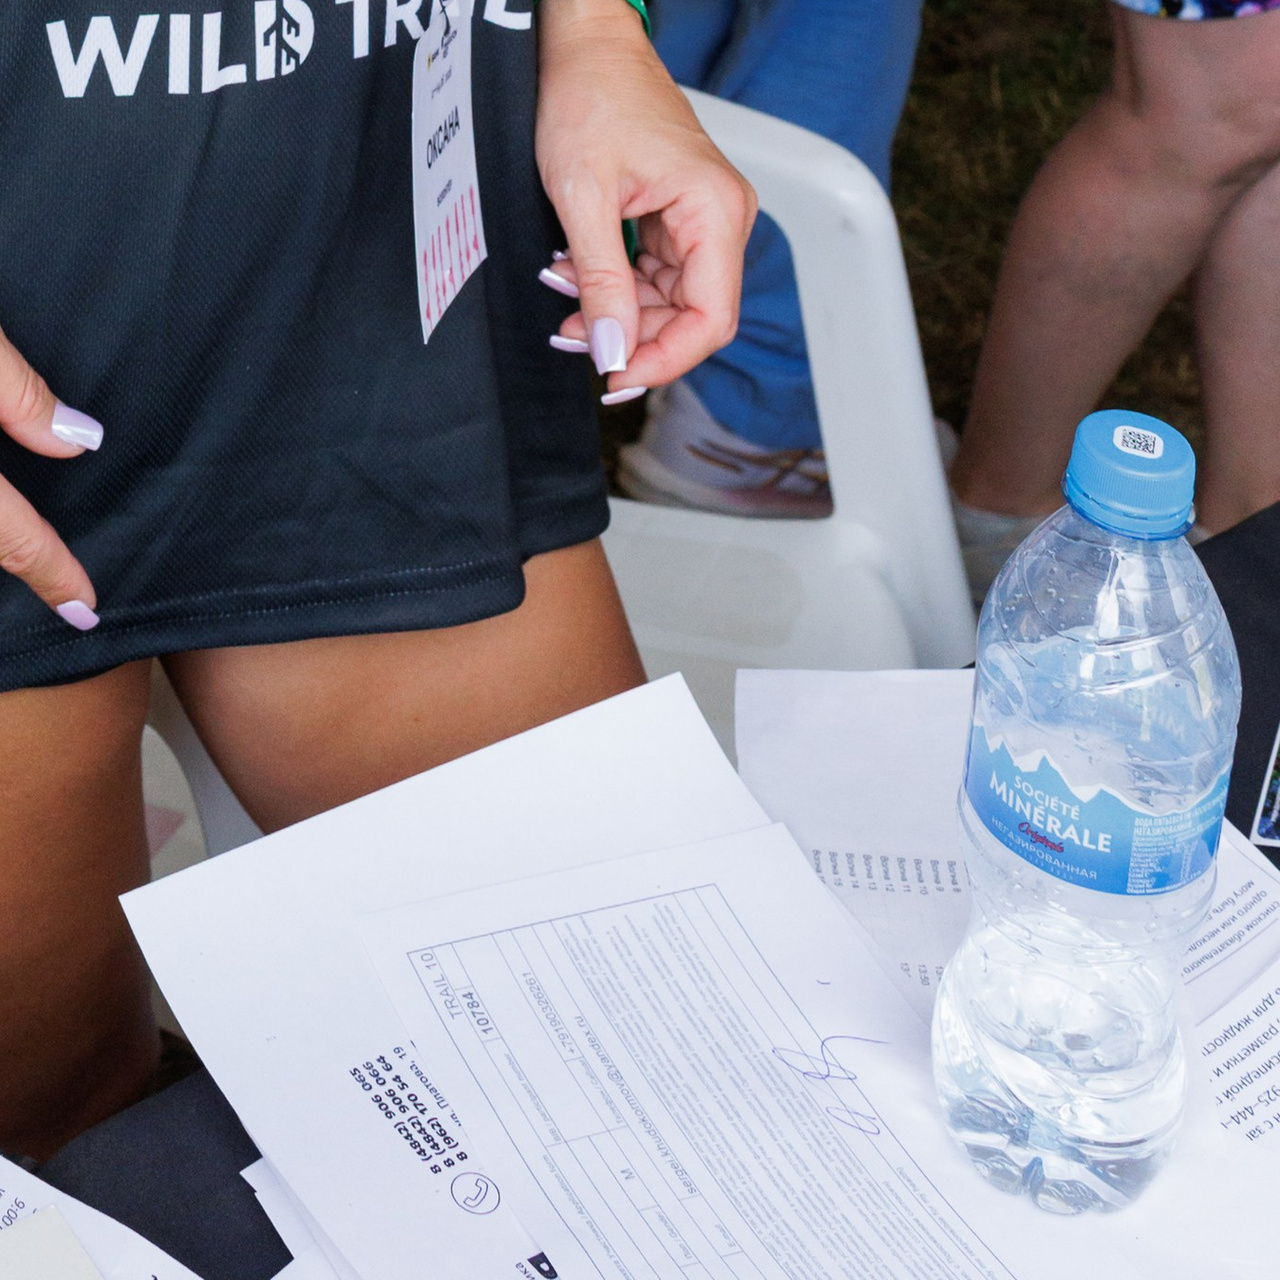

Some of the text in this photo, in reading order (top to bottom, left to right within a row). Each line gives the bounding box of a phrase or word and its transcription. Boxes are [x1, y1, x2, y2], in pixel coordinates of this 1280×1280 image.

[989, 769, 1113, 853] MINÉRALE
[1014, 775, 1081, 821] SOCIÉTÉ
[991, 816, 1098, 880] НЕГАЗИРОВАННАЯ
[919, 886, 929, 896] 10
[420, 952, 463, 1020] TRAIL 10
[1252, 993, 1276, 1018] для
[462, 991, 494, 1035] 10784
[393, 1046, 407, 1060] 19
[1222, 1023, 1279, 1071] разметки
[376, 1055, 468, 1161] 8 (962) 170 54 64
[409, 1060, 450, 1110] Платова,
[574, 1015, 697, 1195] sergei.khudokormov@yandex.ru
[349, 1067, 442, 1174] 8 (4842) 906 065
[362, 1061, 455, 1168] 8 (4842) 906 066
[1, 1197, 26, 1227] 9:00
